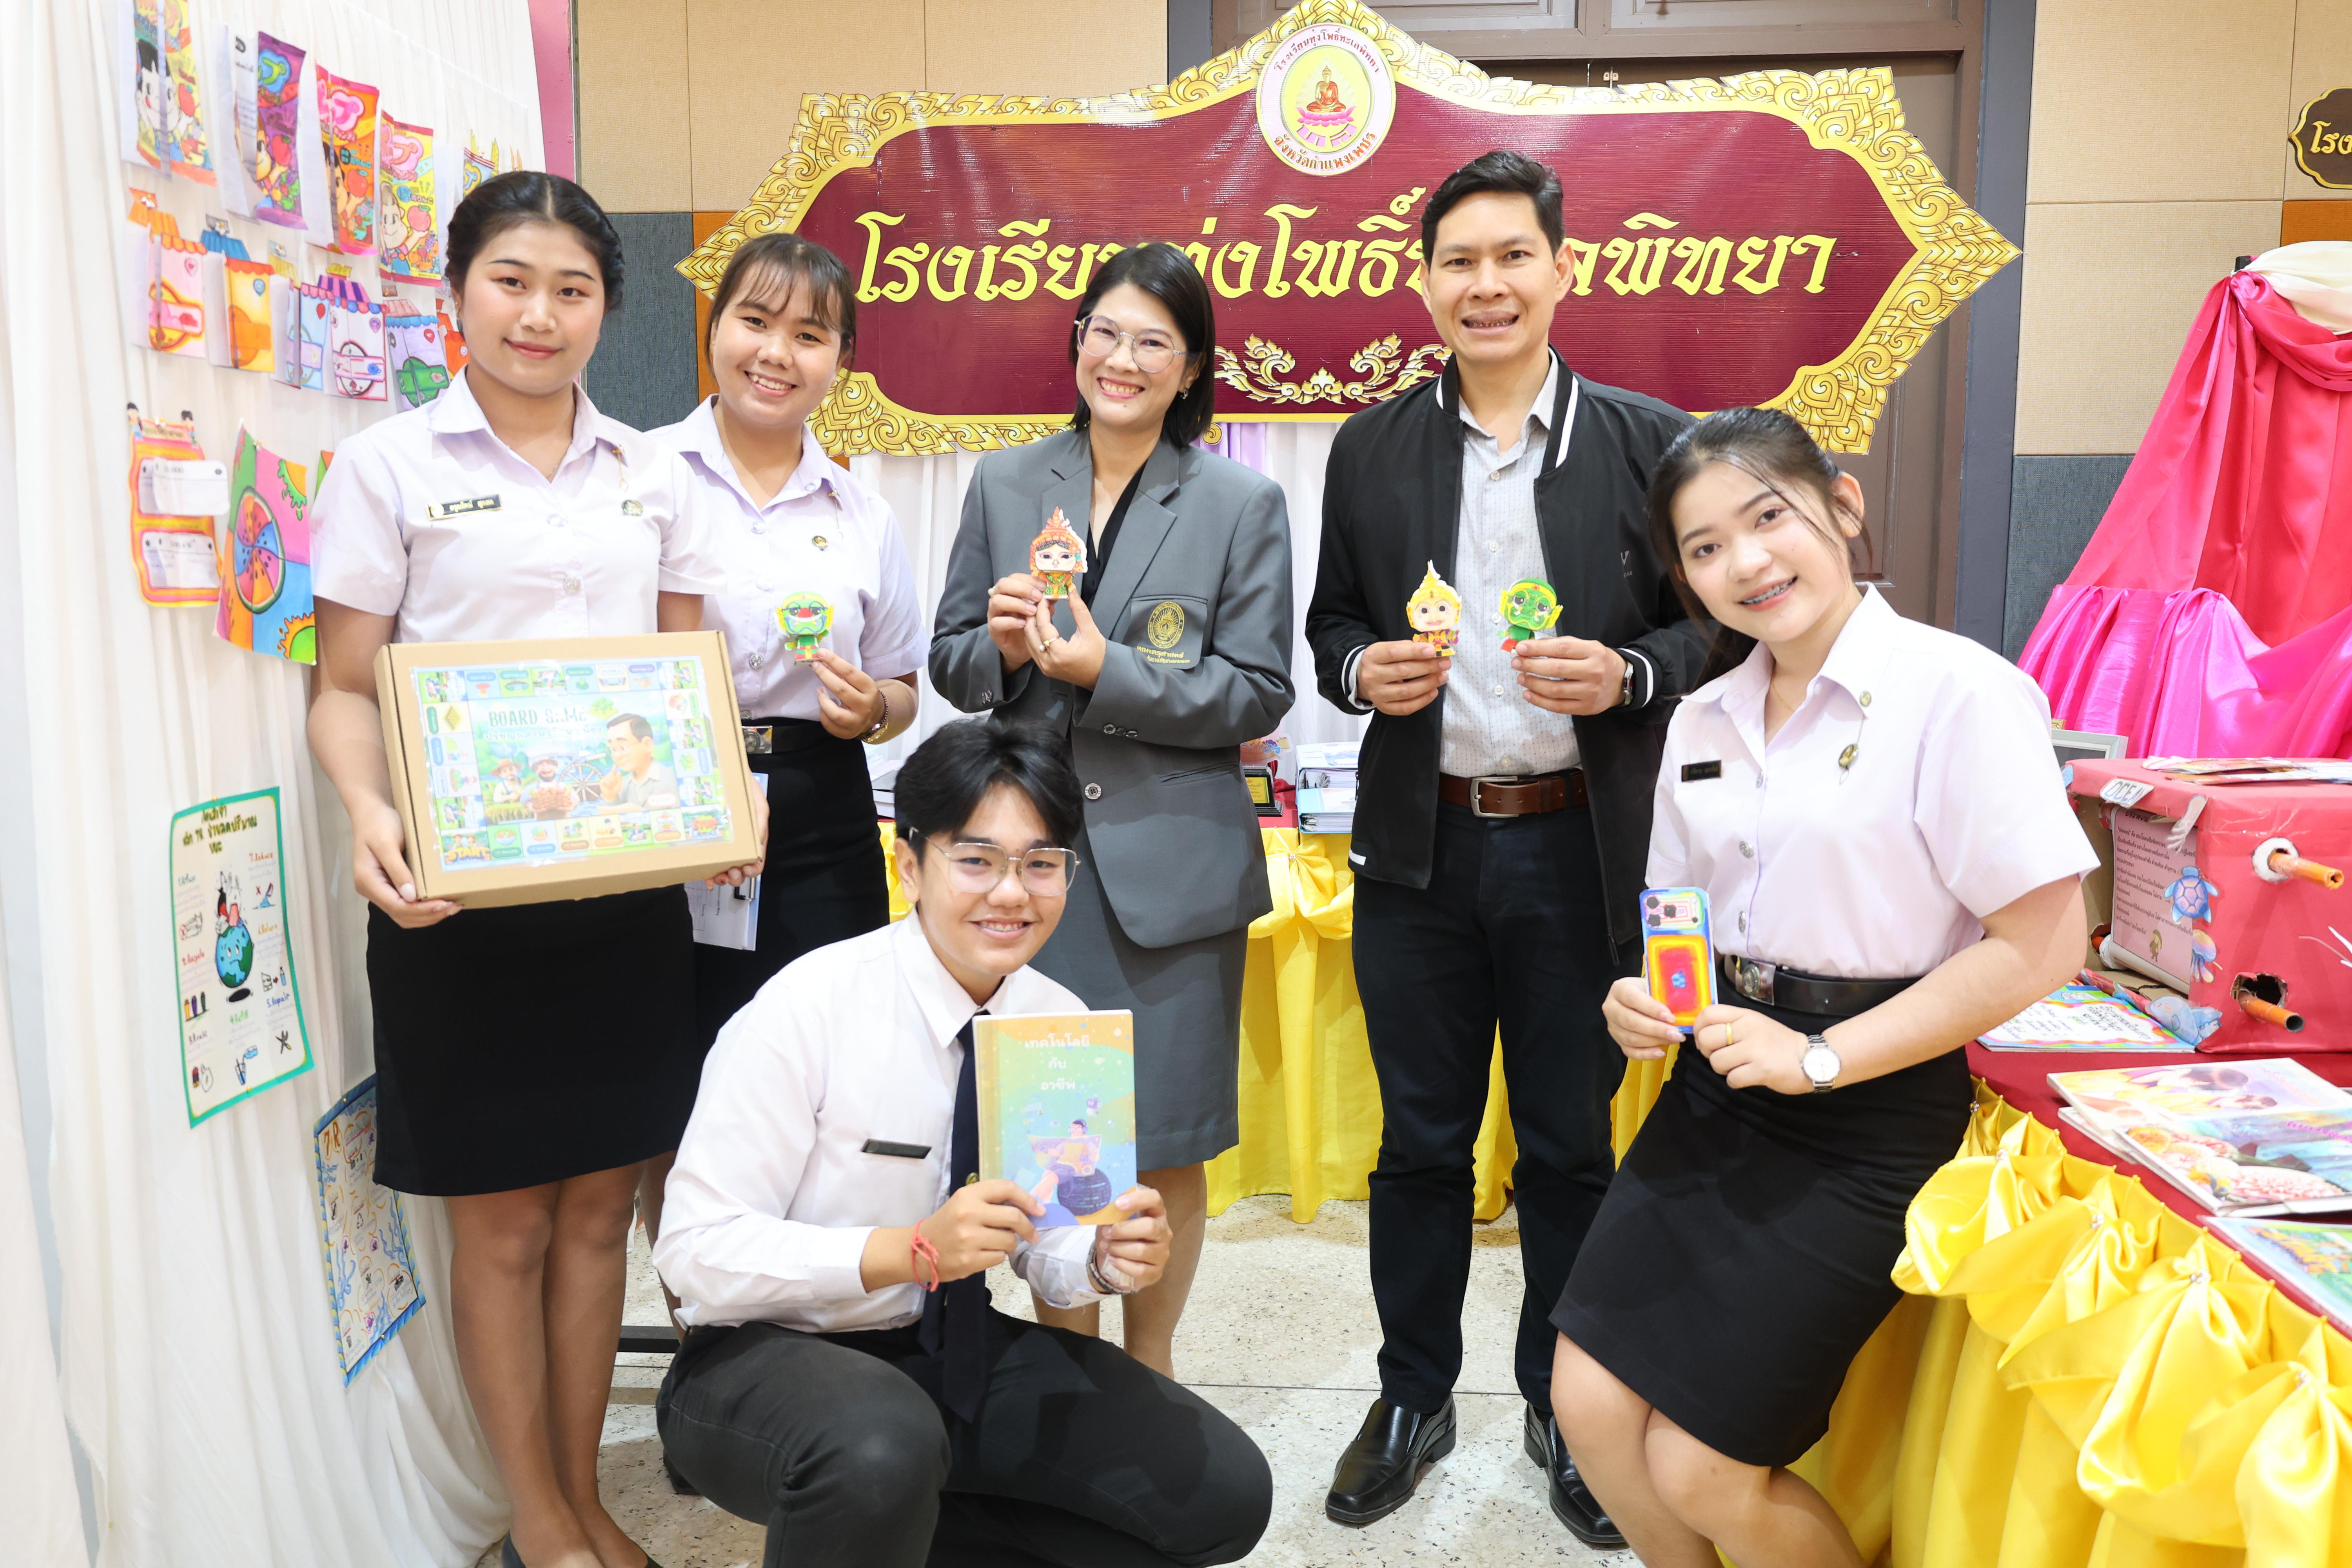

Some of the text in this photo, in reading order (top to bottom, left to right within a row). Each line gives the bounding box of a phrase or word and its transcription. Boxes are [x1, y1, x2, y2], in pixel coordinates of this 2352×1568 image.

[1274, 27, 1380, 74] โรงเรียนทุ่งโพธิ์ทะเลพิทยา
[1274, 132, 1378, 171] จังหวัดกำแพงเพชร
[488, 706, 587, 727] BOARD GME
[1024, 1033, 1091, 1049] เทคโนโลยี
[1048, 1056, 1067, 1069] กับ
[1040, 1077, 1076, 1091] อาชีพ
